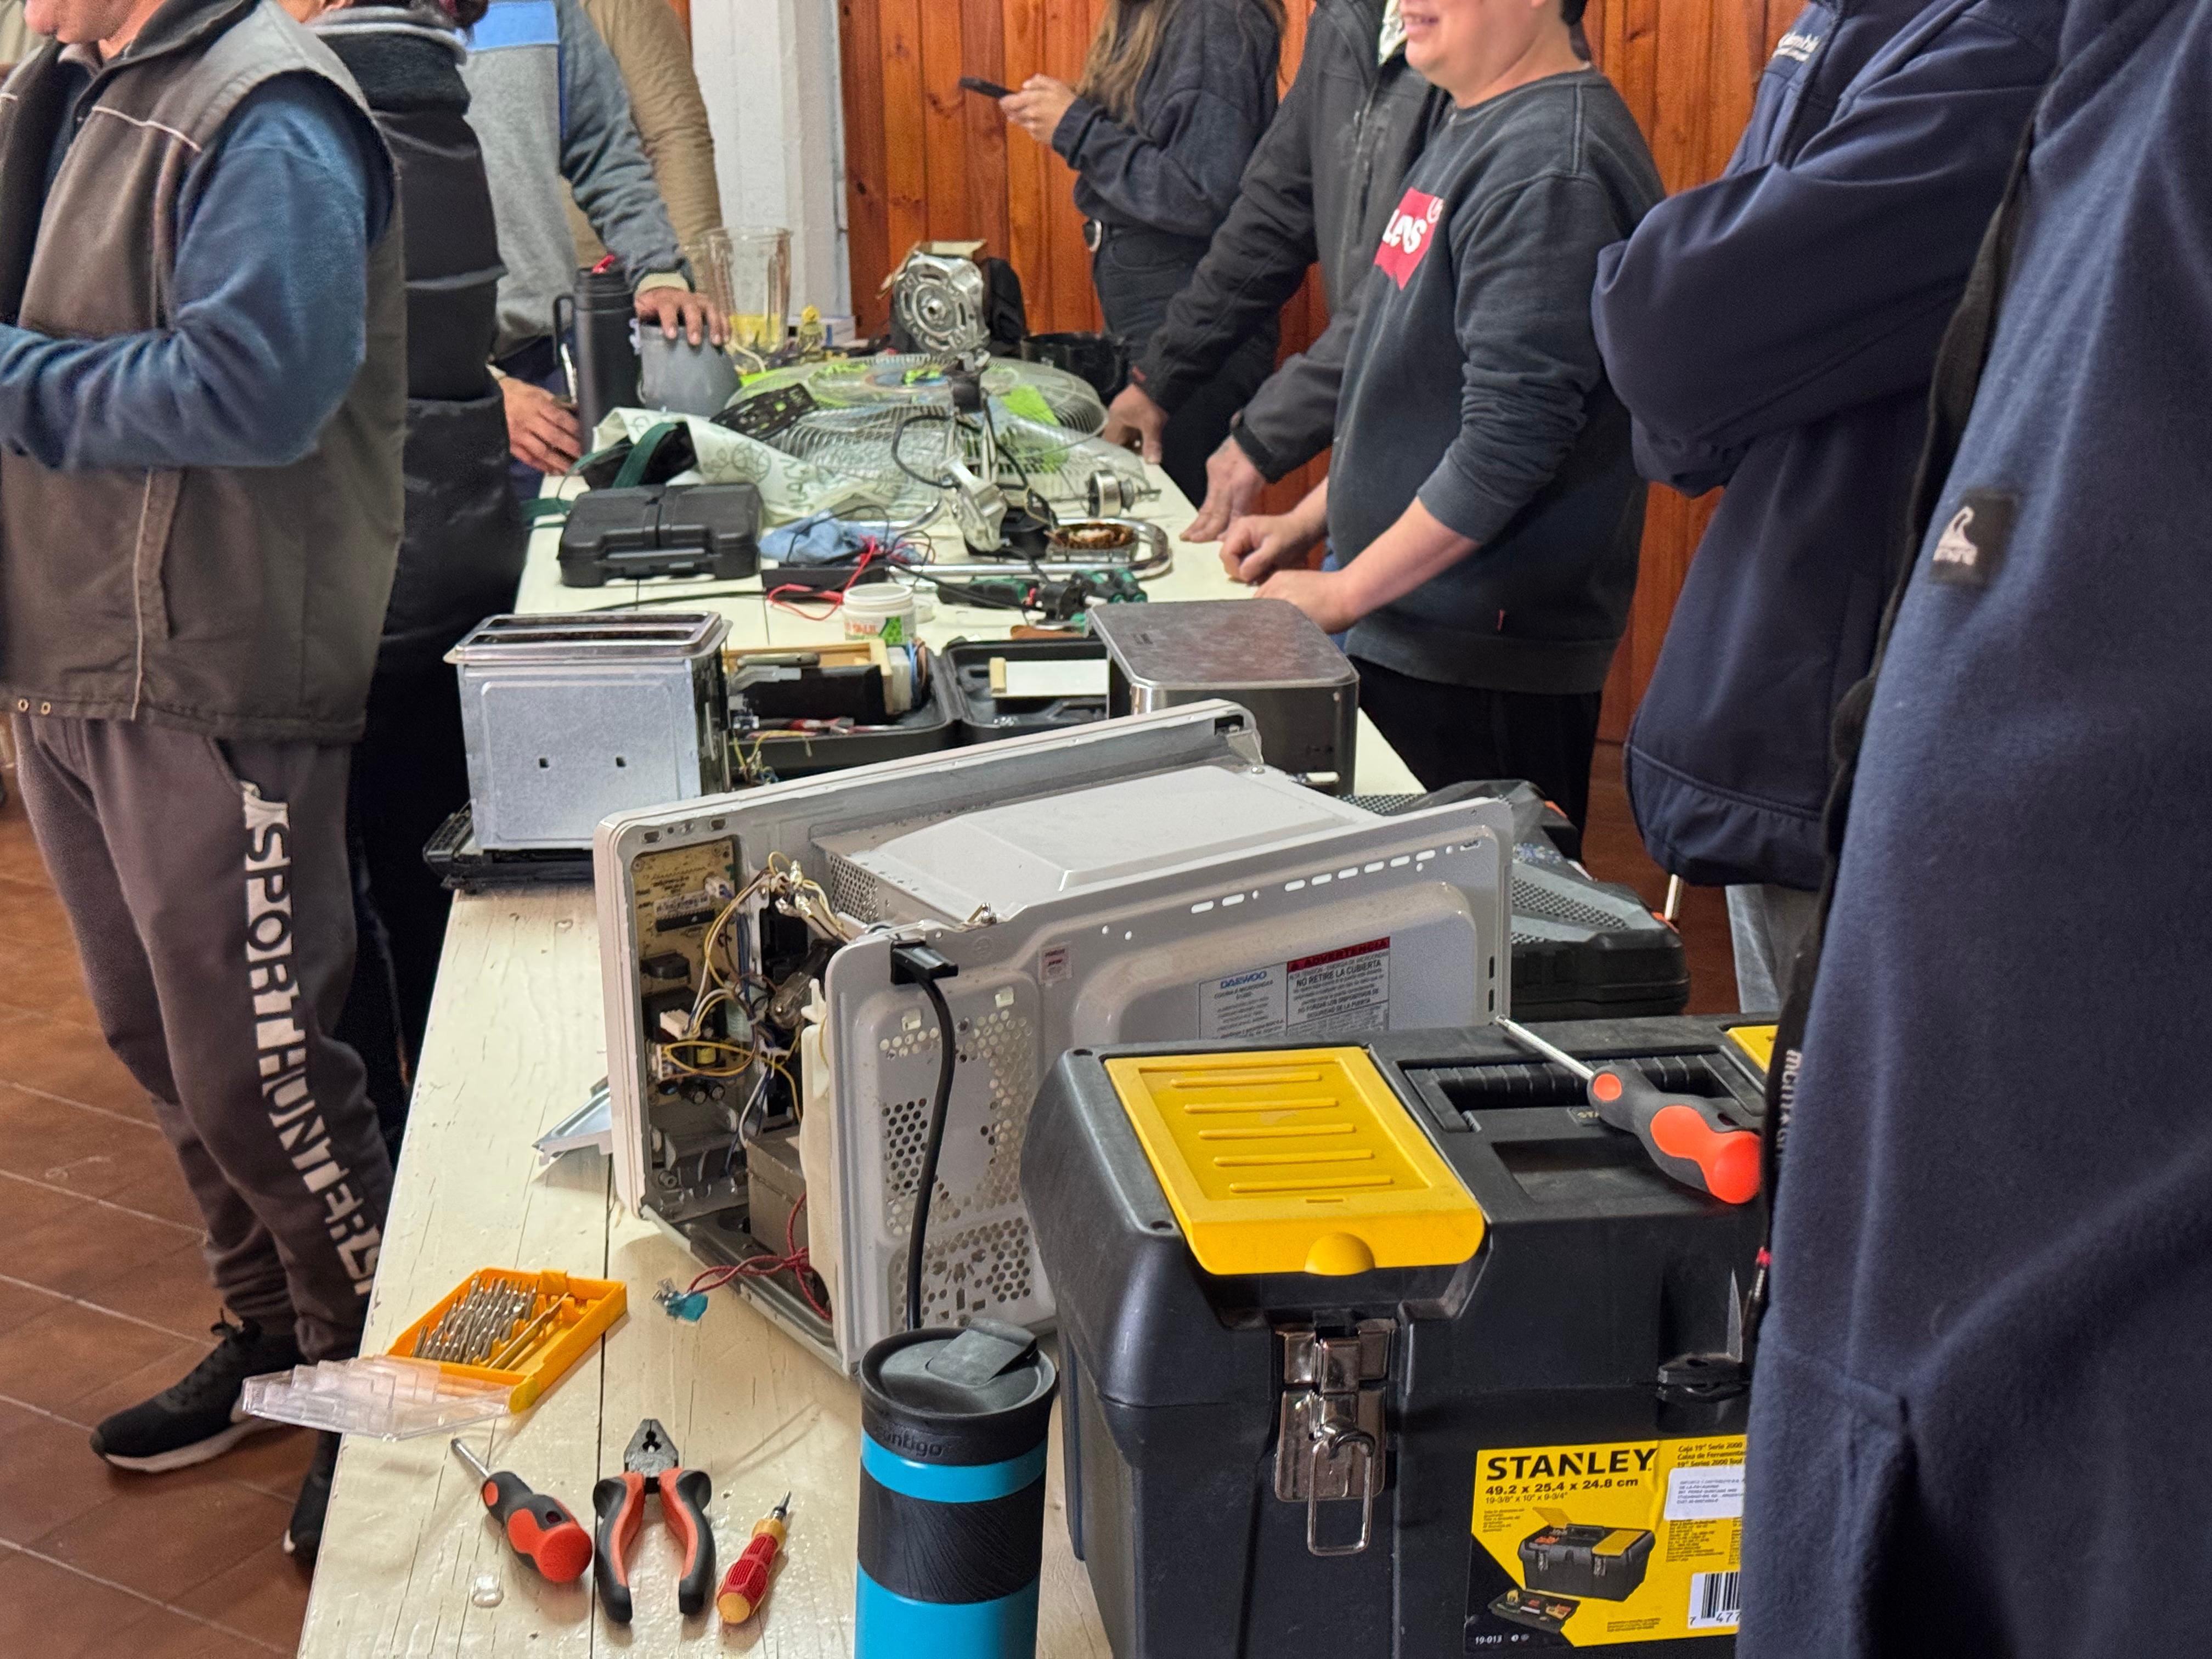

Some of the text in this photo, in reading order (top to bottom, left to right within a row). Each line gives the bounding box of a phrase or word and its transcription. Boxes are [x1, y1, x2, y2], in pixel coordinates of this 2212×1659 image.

[1220, 970, 1267, 989] DAEWOO
[1296, 977, 1307, 987] NO
[1308, 971, 1334, 984] RETIRE
[1336, 968, 1346, 977] LA
[1347, 960, 1381, 974] CUBIERTA
[1678, 1445, 1693, 1453] Caja
[1486, 1448, 1657, 1481] STANLEY
[1485, 1479, 1638, 1495] 49.2 x 25.4 x 24.8 cm
[1690, 1616, 1696, 1625] 7
